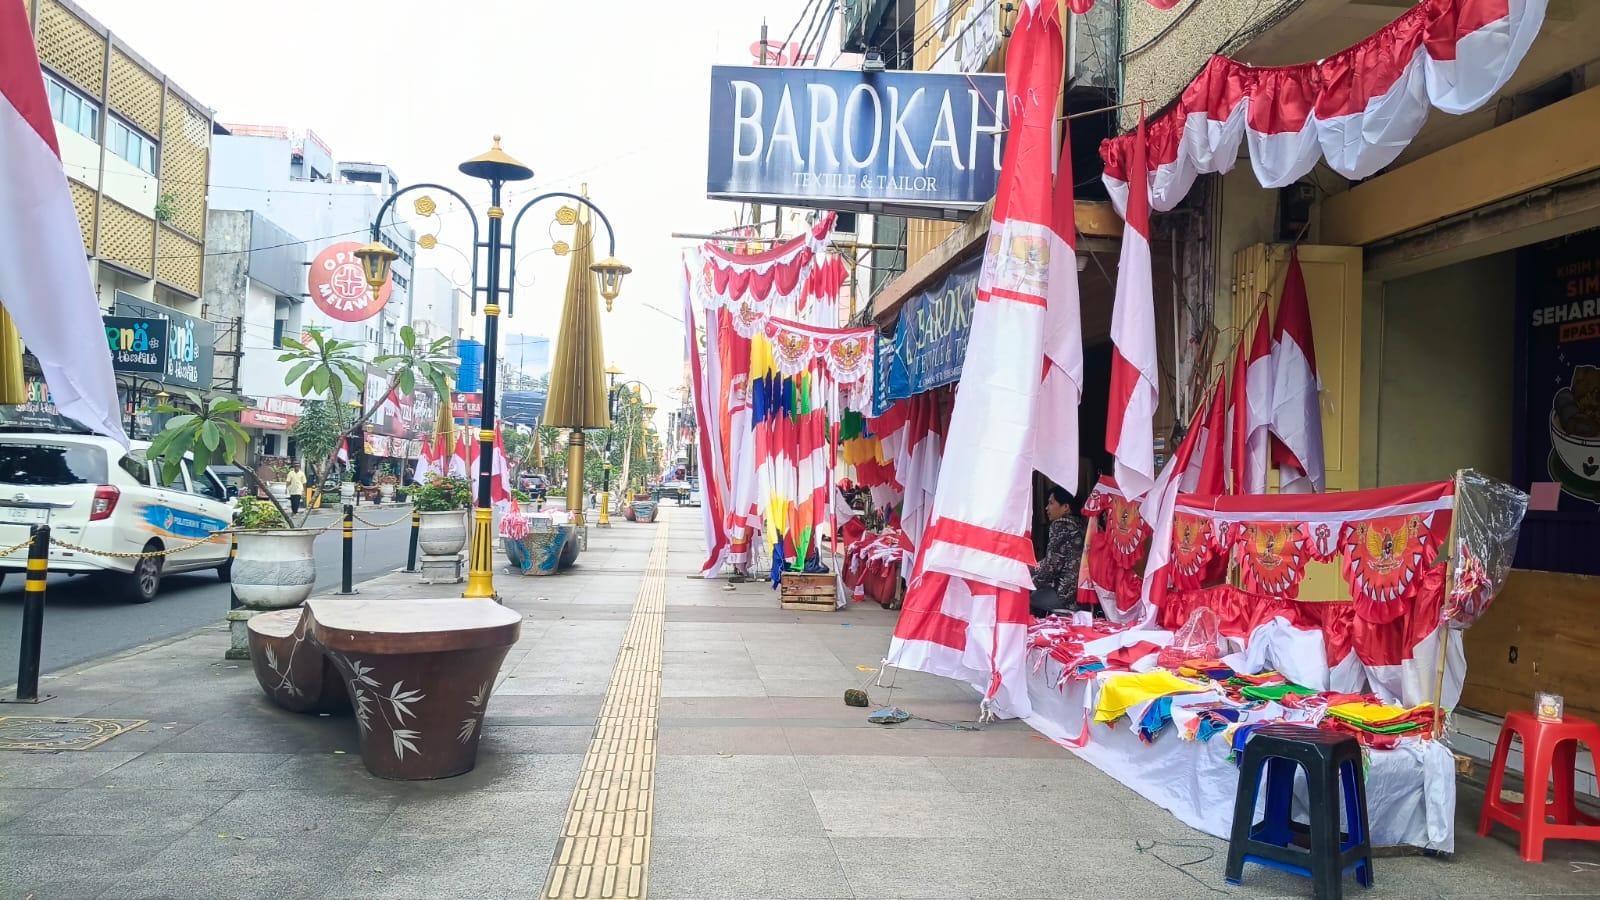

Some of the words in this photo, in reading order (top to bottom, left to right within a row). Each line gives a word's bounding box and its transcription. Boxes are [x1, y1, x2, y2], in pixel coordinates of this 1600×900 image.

[729, 80, 1005, 171] BAROKAH
[792, 172, 856, 191] TEXTILE
[860, 175, 873, 190] &
[876, 175, 937, 191] TAILOR
[916, 277, 977, 350] BAROKA
